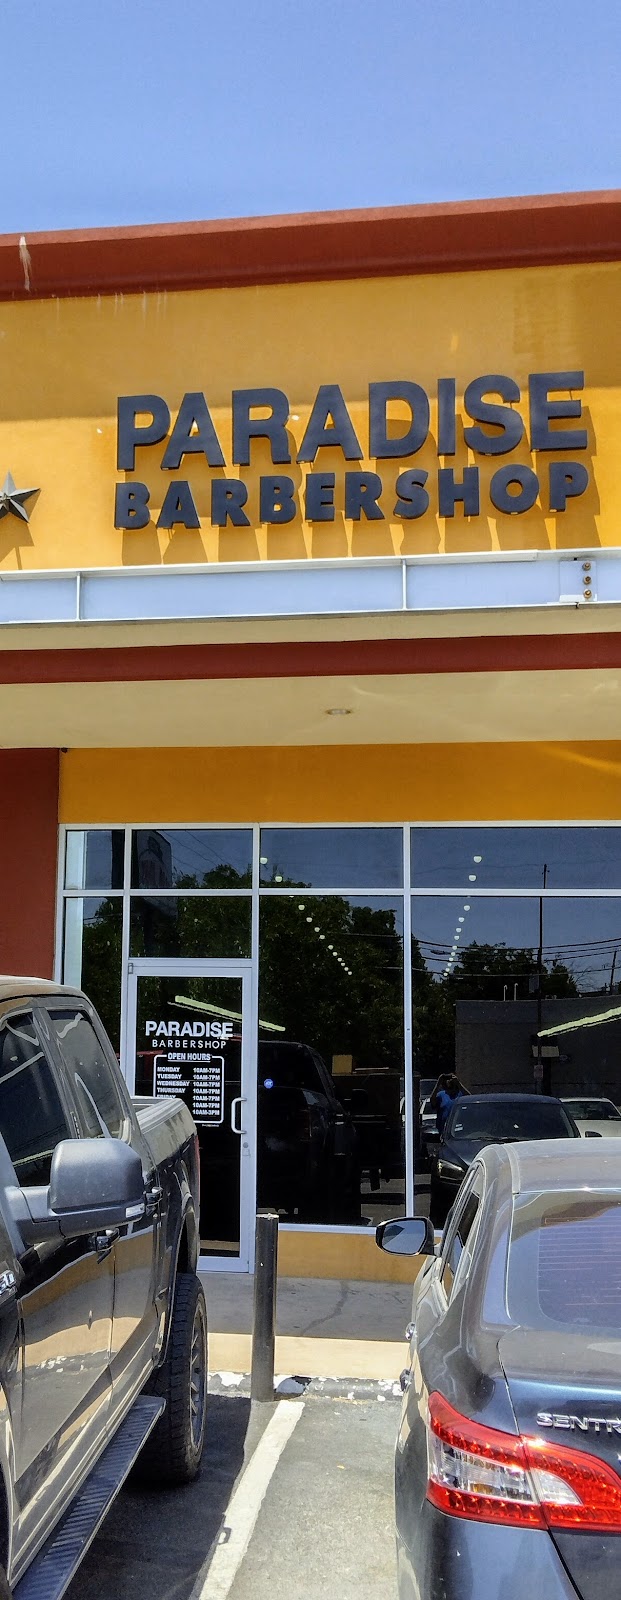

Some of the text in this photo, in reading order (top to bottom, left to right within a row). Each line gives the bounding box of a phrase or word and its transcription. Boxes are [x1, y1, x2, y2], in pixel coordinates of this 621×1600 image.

[116, 371, 588, 472] PARADISE
[114, 461, 589, 531] BARBERSHOP
[145, 1021, 233, 1038] PARADISE
[152, 1040, 226, 1049] BARBERSHOP
[167, 1052, 211, 1061] OPEN HOURS
